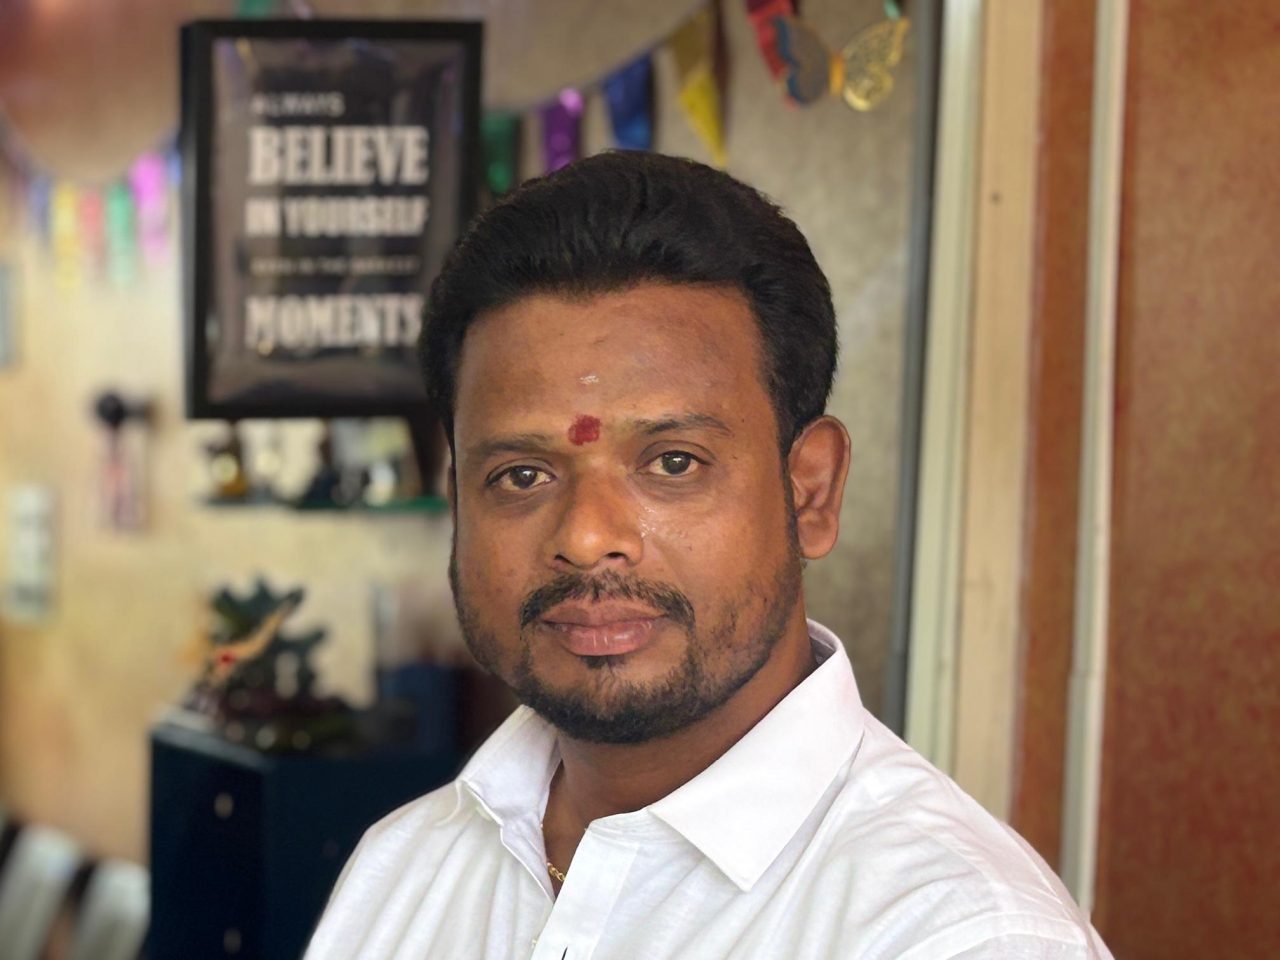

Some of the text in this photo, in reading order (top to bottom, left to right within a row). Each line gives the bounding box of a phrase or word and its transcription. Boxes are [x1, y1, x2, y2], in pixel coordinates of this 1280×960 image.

[248, 126, 428, 185] BELIEVE
[245, 196, 428, 238] IN YOURSELF
